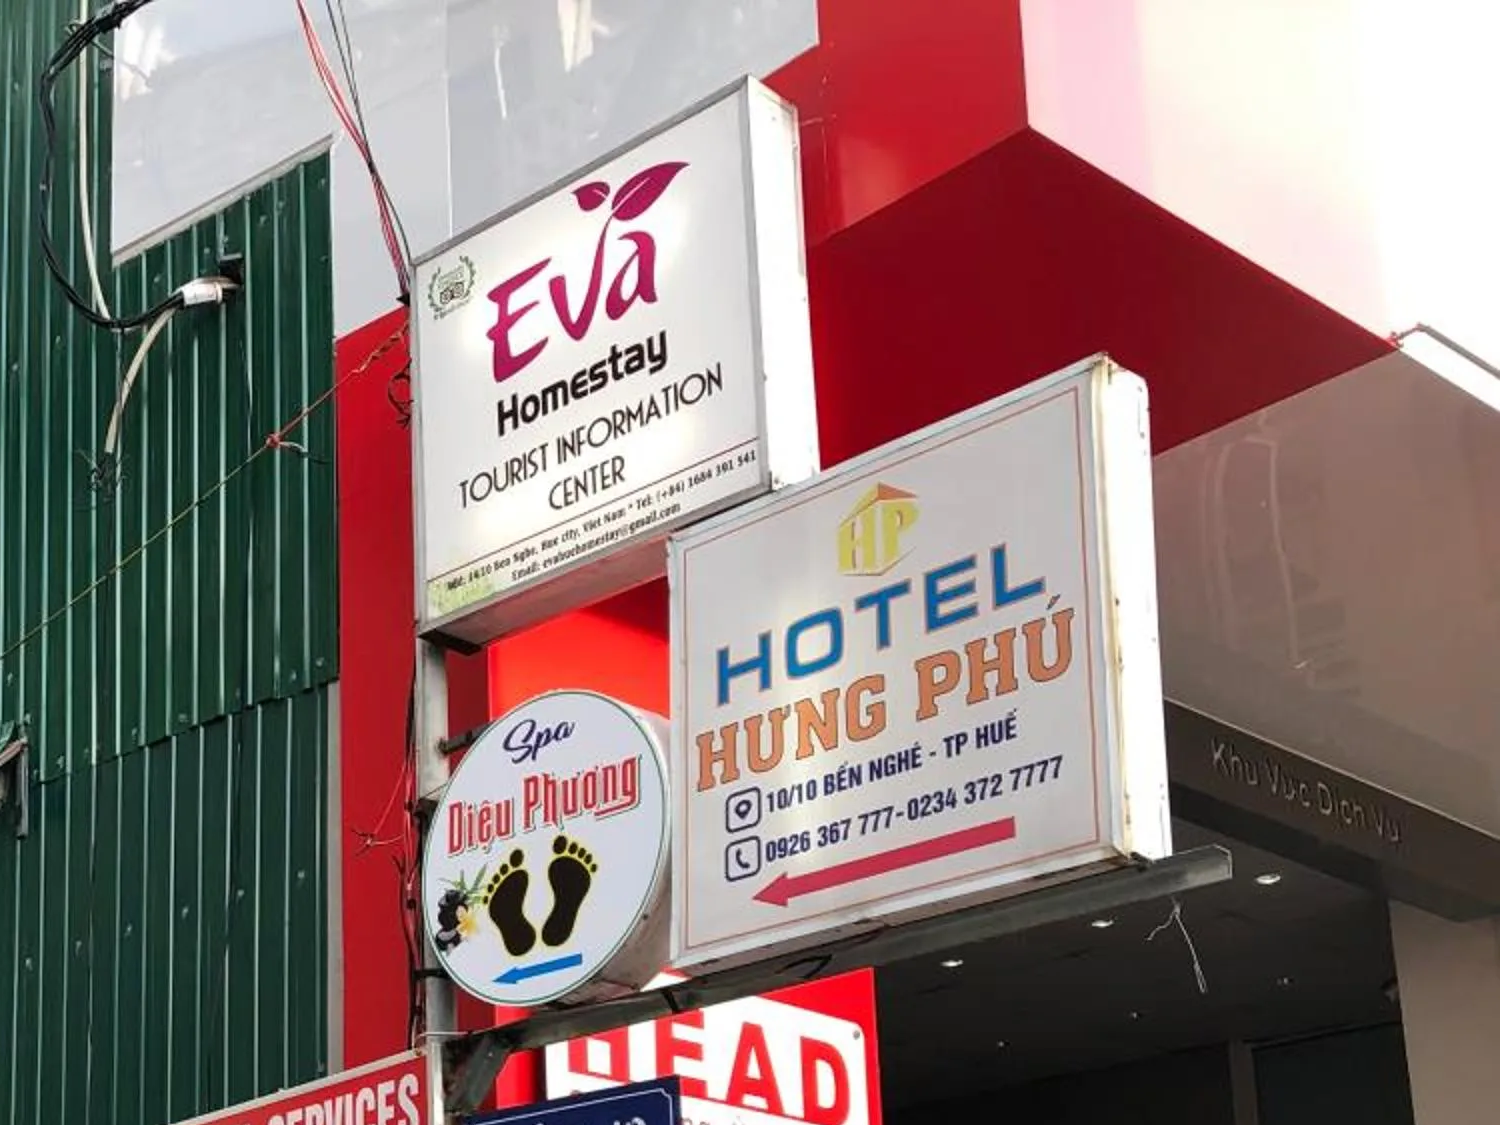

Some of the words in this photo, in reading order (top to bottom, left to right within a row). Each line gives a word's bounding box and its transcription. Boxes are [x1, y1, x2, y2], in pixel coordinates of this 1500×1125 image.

[460, 441, 549, 509] TOURIST
[556, 362, 724, 466] INFORMATION
[496, 329, 668, 437] Homestay
[548, 455, 626, 511] CENTER
[716, 543, 1046, 707] HOTEL
[502, 718, 576, 765] Spa
[695, 674, 887, 792] HƯNG
[915, 594, 1075, 722] PHÚ
[447, 796, 516, 858] Diệu
[521, 753, 643, 833] Phương
[765, 829, 812, 863] 0926
[817, 818, 851, 847] 367
[964, 773, 1004, 806] 372
[1009, 754, 1064, 794] 7777
[766, 779, 818, 814] 10/10
[823, 757, 863, 797] BẾN
[869, 744, 924, 779] NGHÉ
[943, 730, 969, 758] TP
[975, 708, 1018, 748] HUẾ
